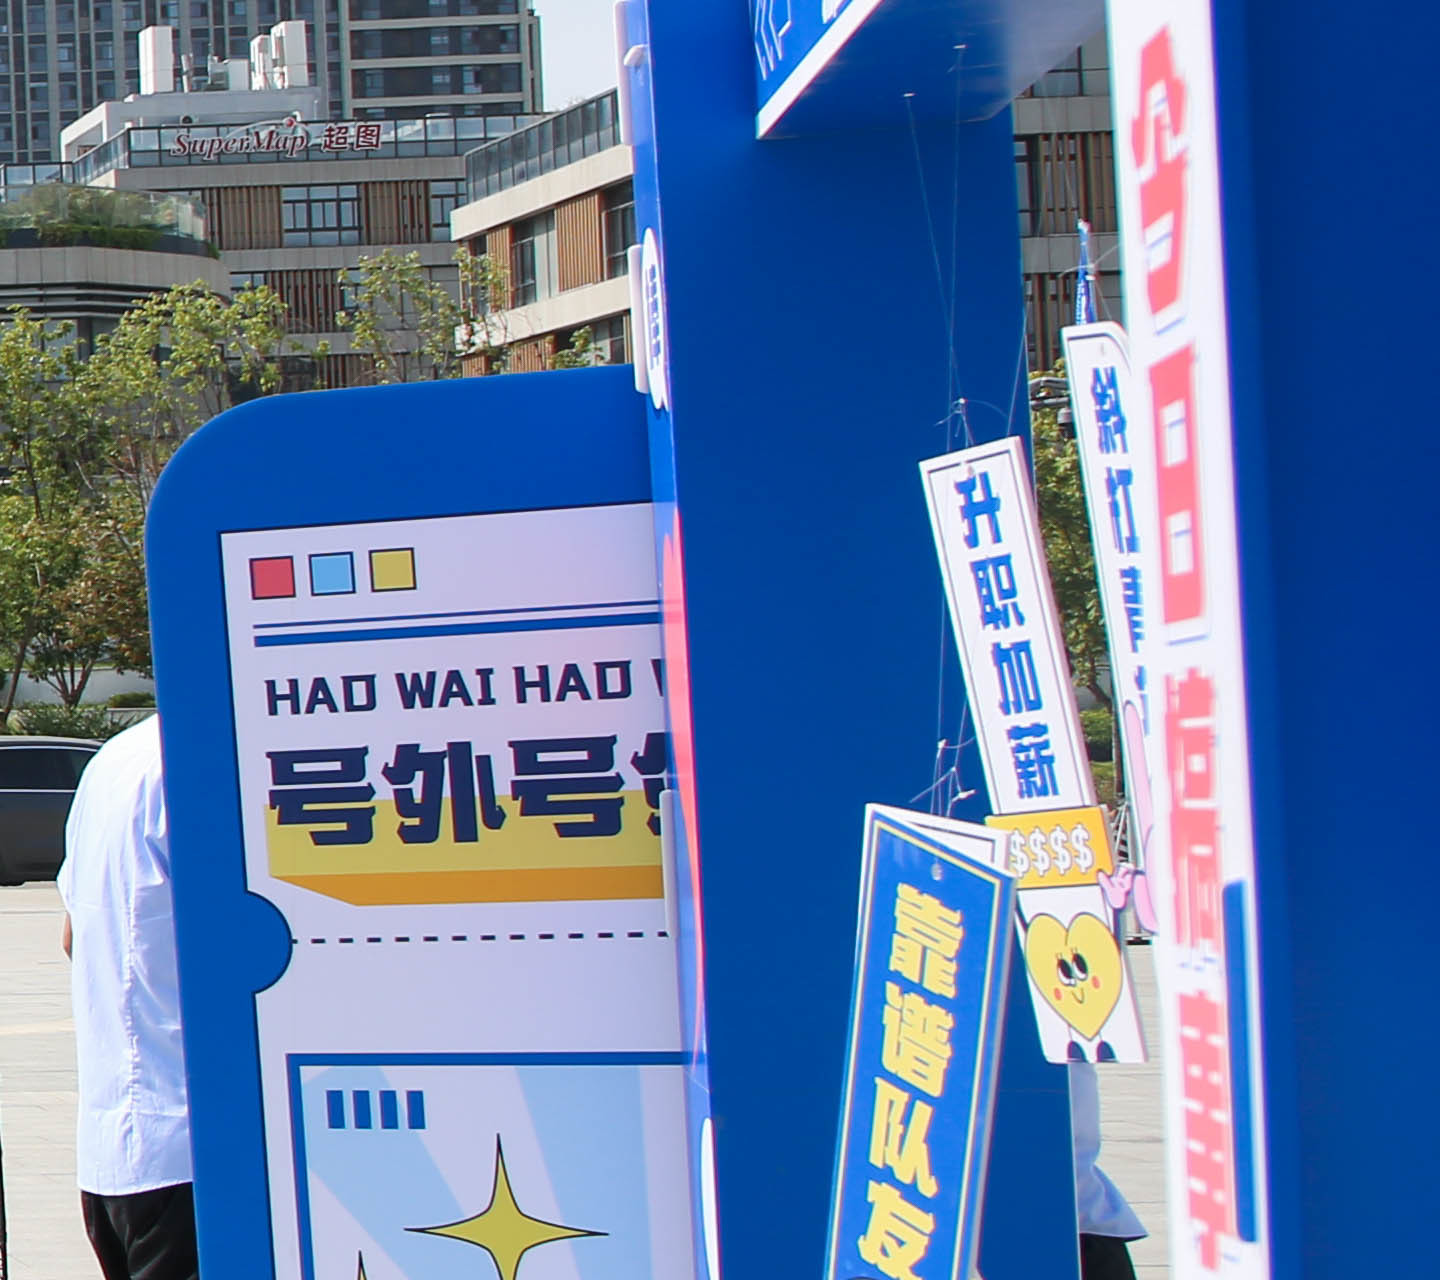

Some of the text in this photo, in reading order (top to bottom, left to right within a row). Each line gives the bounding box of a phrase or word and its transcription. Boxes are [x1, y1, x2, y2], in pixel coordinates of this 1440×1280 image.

[171, 124, 383, 160] SuperMap 超图
[954, 471, 1061, 800] 升职加薪
[396, 667, 496, 709] WAI
